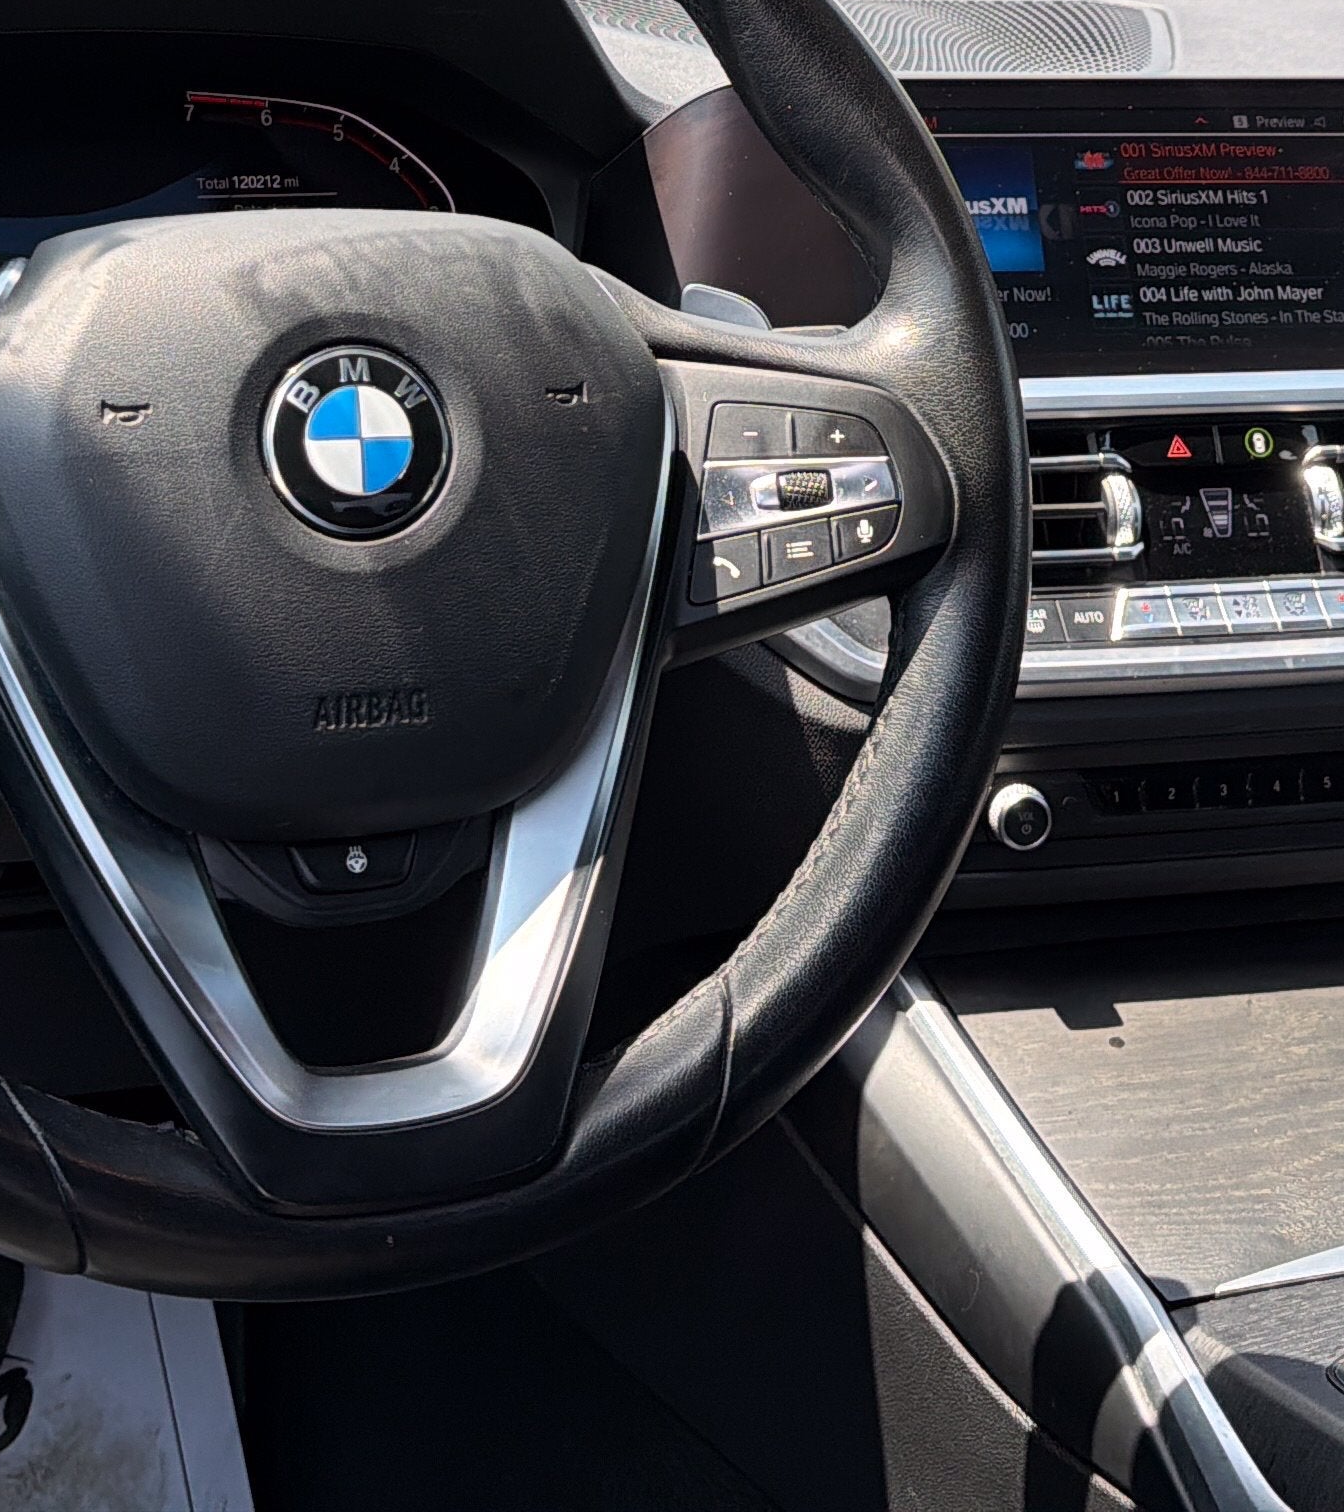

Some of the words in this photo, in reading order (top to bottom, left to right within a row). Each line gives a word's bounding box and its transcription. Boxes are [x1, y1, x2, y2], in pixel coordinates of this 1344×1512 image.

[184, 105, 194, 121] 7
[260, 109, 273, 126] 6
[1256, 116, 1305, 128] Preview
[332, 124, 344, 141] 5
[1120, 143, 1146, 157] 001
[1151, 142, 1217, 157] SiriusXM
[1221, 142, 1276, 157] Preview
[389, 157, 400, 174] 4
[1124, 167, 1159, 180] Great
[1164, 166, 1196, 180] Offer
[1200, 166, 1233, 180] Now!
[1244, 166, 1331, 180] 844-711-8800
[196, 176, 229, 189] Total
[232, 175, 281, 189] 120212
[284, 176, 299, 188] mi
[1127, 190, 1154, 206] 002
[1156, 190, 1223, 205] SiriusXM
[1227, 189, 1258, 204] Hits
[1261, 190, 1268, 204] 1
[1130, 215, 1167, 228] Icona
[1171, 215, 1197, 230] Pop
[1216, 214, 1249, 227] Love
[1251, 215, 1260, 227] It
[1133, 239, 1161, 254] 003
[1164, 238, 1213, 253] Unwell
[1218, 238, 1262, 253] Music
[1086, 248, 1127, 265] UNWELL
[1137, 263, 1187, 279] Maggie
[1190, 263, 1238, 279] Rogers
[1249, 262, 1292, 276] Alaska
[1014, 286, 1052, 302] Now!
[1092, 294, 1132, 310] LIFE
[1140, 287, 1167, 302] 004
[1170, 286, 1199, 302] Life
[1202, 286, 1233, 301] with
[1236, 286, 1274, 301] John
[1277, 286, 1324, 303] Mayer
[1142, 311, 1169, 326] The
[1172, 311, 1219, 327] Rolling
[1222, 310, 1269, 325] Stones
[1279, 310, 1292, 323] In
[1294, 309, 1321, 323] The
[286, 356, 429, 415] BMW
[1172, 543, 1192, 555] A/C
[1073, 611, 1104, 624] AUTO
[311, 690, 431, 733] AIRBAG
[1114, 790, 1120, 803] 1
[1168, 788, 1175, 800] 2
[1220, 784, 1228, 796] 3
[1273, 780, 1281, 792] 4
[1323, 776, 1331, 789] 5
